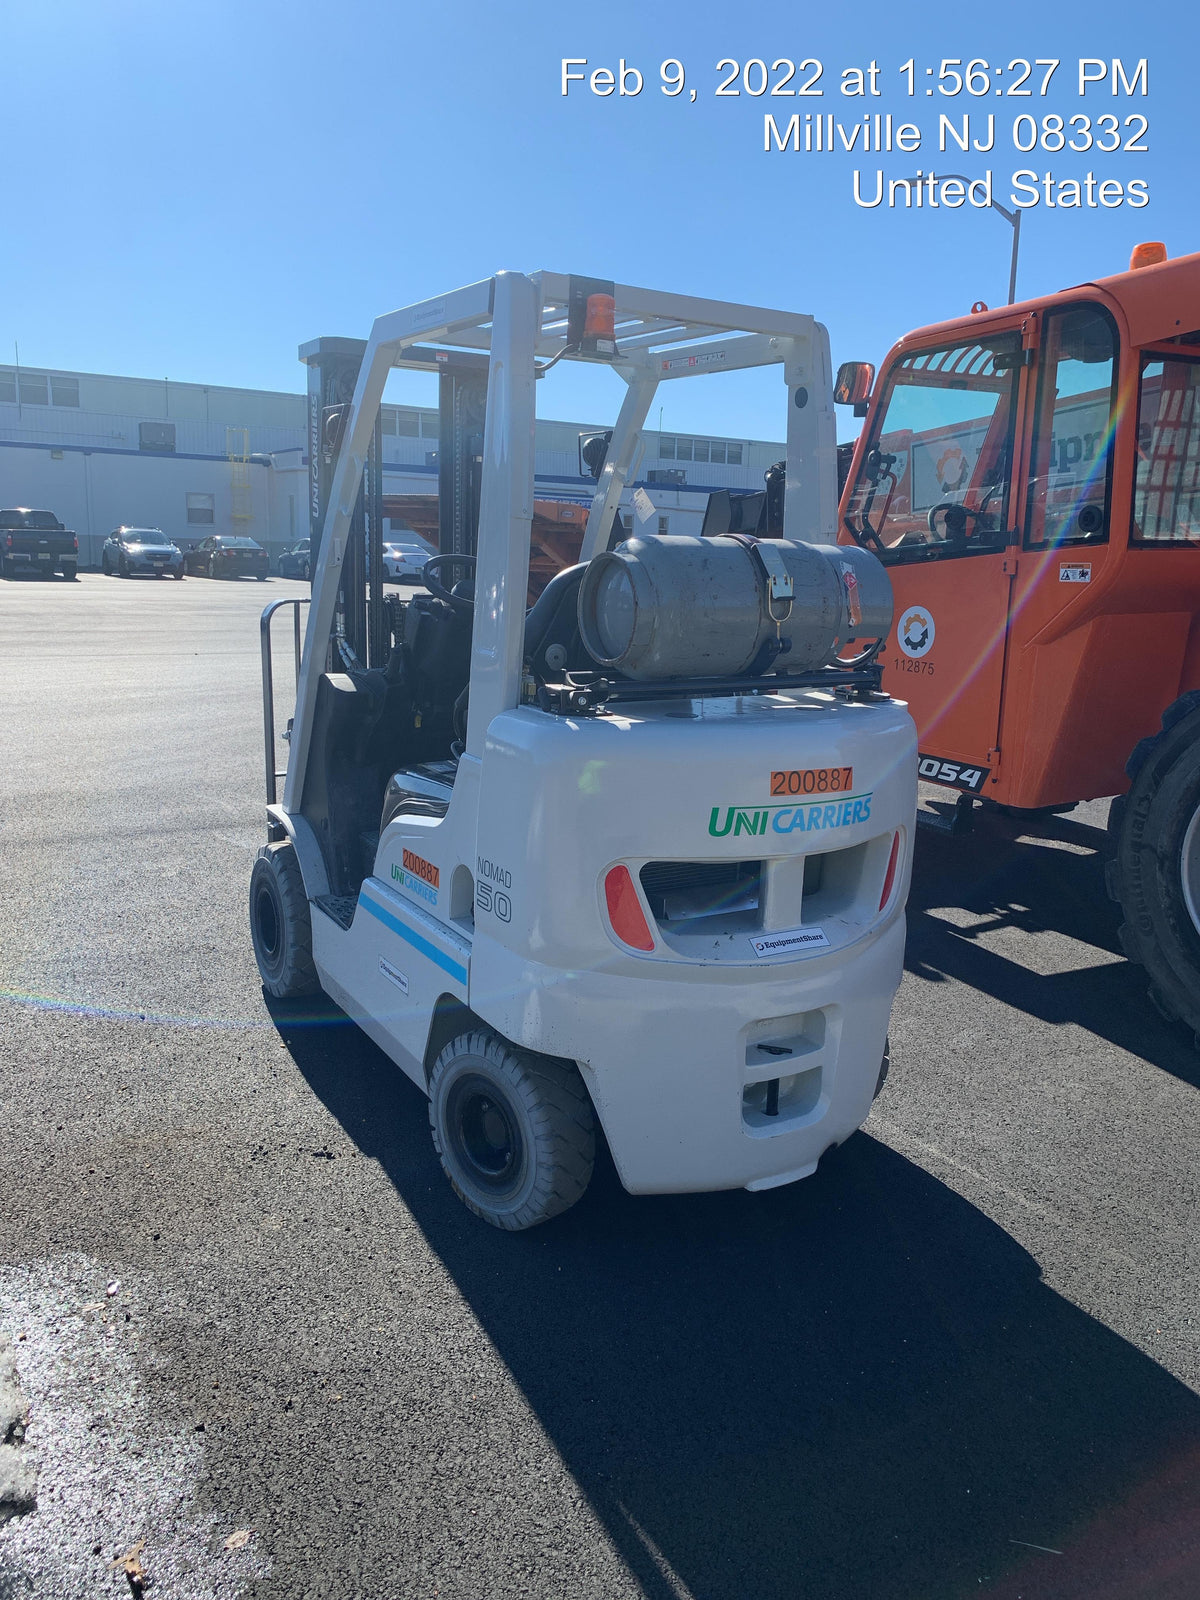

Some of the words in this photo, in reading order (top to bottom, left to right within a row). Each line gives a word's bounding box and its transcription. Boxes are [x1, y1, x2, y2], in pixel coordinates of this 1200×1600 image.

[894, 658, 935, 676] 112875
[772, 767, 853, 795] 200887
[917, 757, 982, 788] 054
[403, 849, 439, 887] 200887
[477, 856, 512, 889] NOMAD
[476, 879, 512, 924] 50
[763, 933, 824, 950] EquipmentShare
